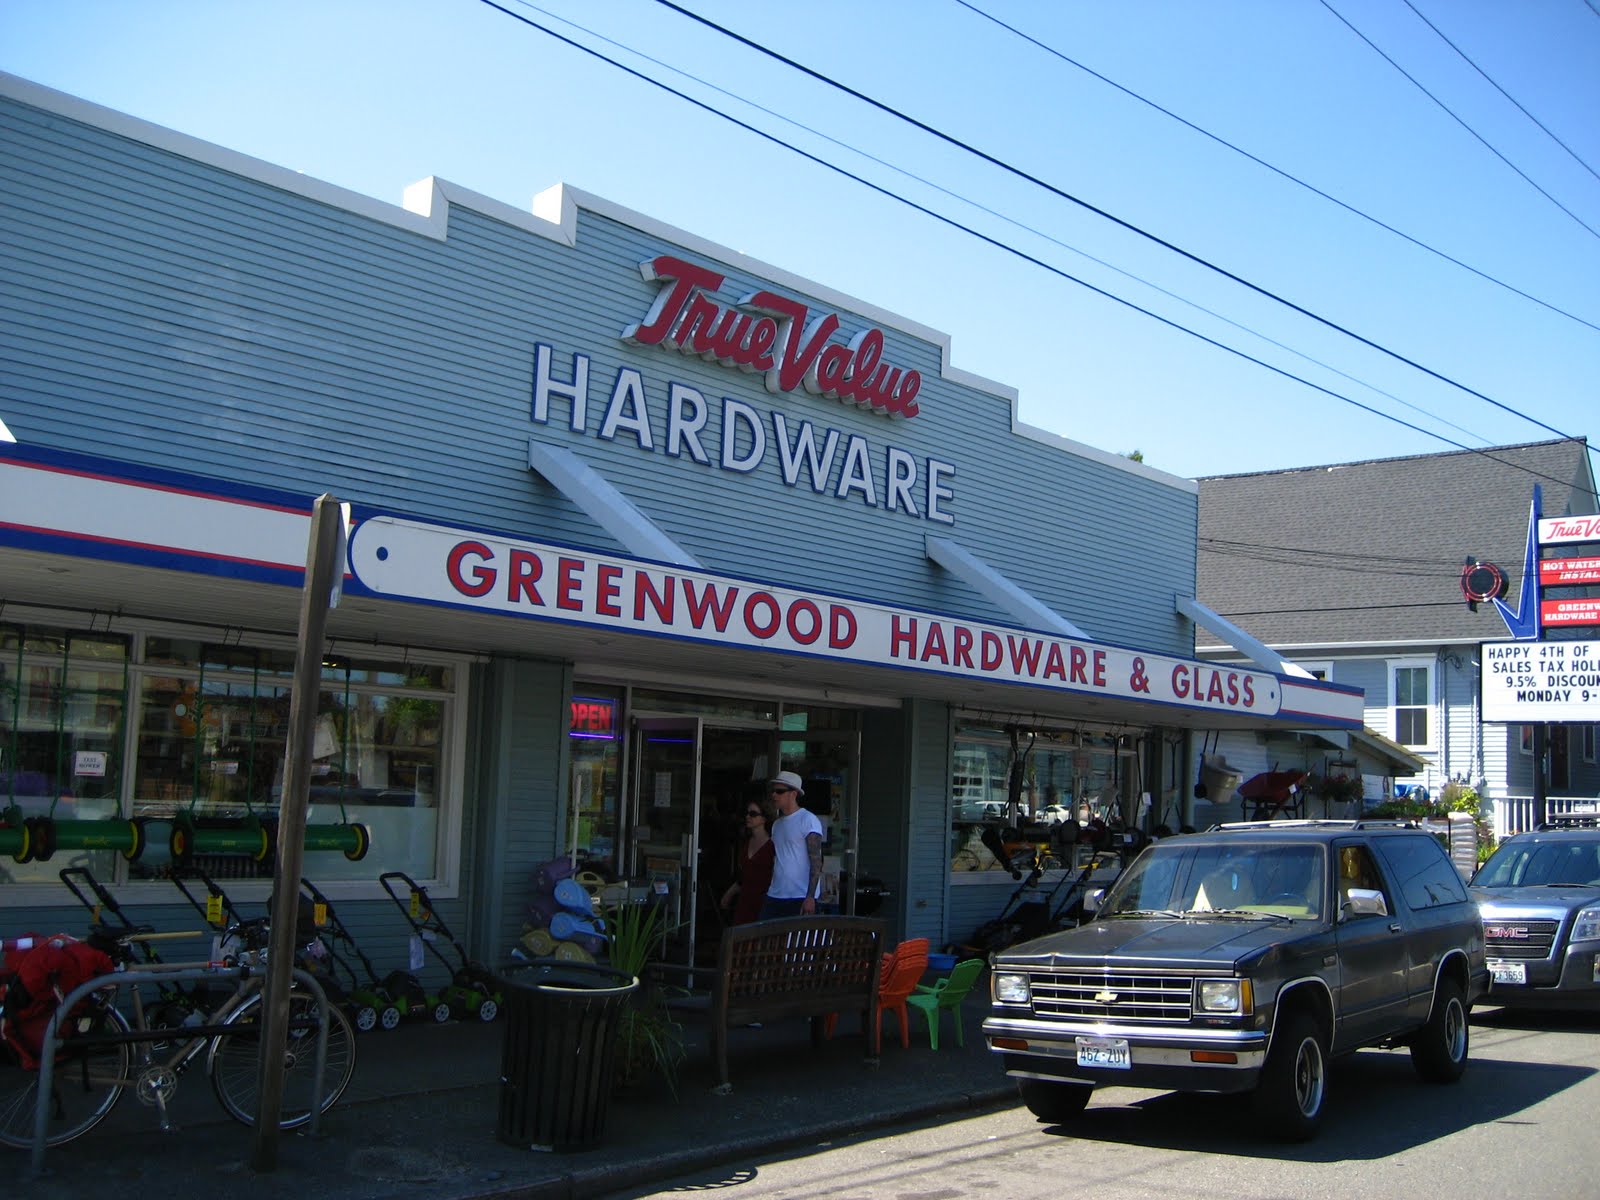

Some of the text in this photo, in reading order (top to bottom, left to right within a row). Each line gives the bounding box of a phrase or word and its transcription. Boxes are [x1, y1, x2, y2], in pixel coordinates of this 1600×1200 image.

[620, 255, 922, 419] True Value
[530, 341, 956, 526] HARDWARE
[1546, 520, 1582, 540] True
[1542, 562, 1564, 571] HOT
[1559, 571, 1600, 580] INSTAL
[1544, 612, 1598, 621] HARDWARE
[446, 540, 1256, 708] GREENWOOD HARDWARE & GLASS
[1488, 645, 1590, 659] HAPPY 4TH OF
[1492, 661, 1532, 674] SALES
[1539, 660, 1565, 673] TAX
[1506, 675, 1537, 688] 9.5%
[1517, 690, 1571, 703] MONDAY
[1485, 926, 1529, 939] GMC
